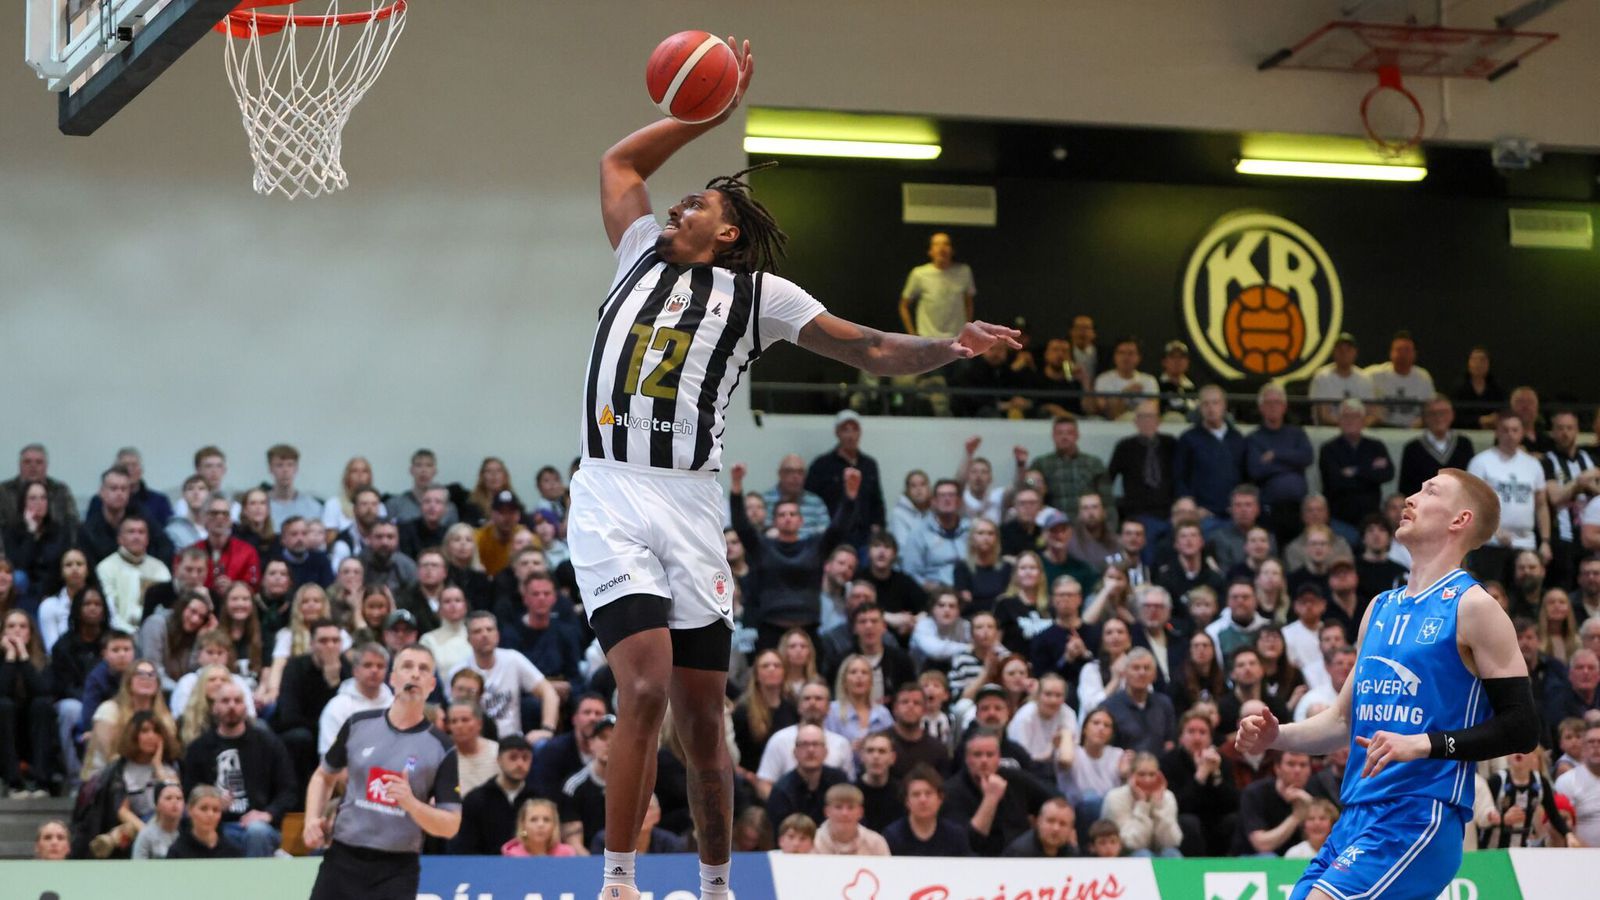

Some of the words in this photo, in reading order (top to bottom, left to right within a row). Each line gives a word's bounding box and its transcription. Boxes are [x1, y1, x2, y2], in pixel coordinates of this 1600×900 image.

[1206, 229, 1322, 361] KR
[623, 323, 692, 400] 12
[614, 412, 694, 435] alvotech
[593, 573, 631, 597] unbroken
[1356, 704, 1424, 725] MSUNG
